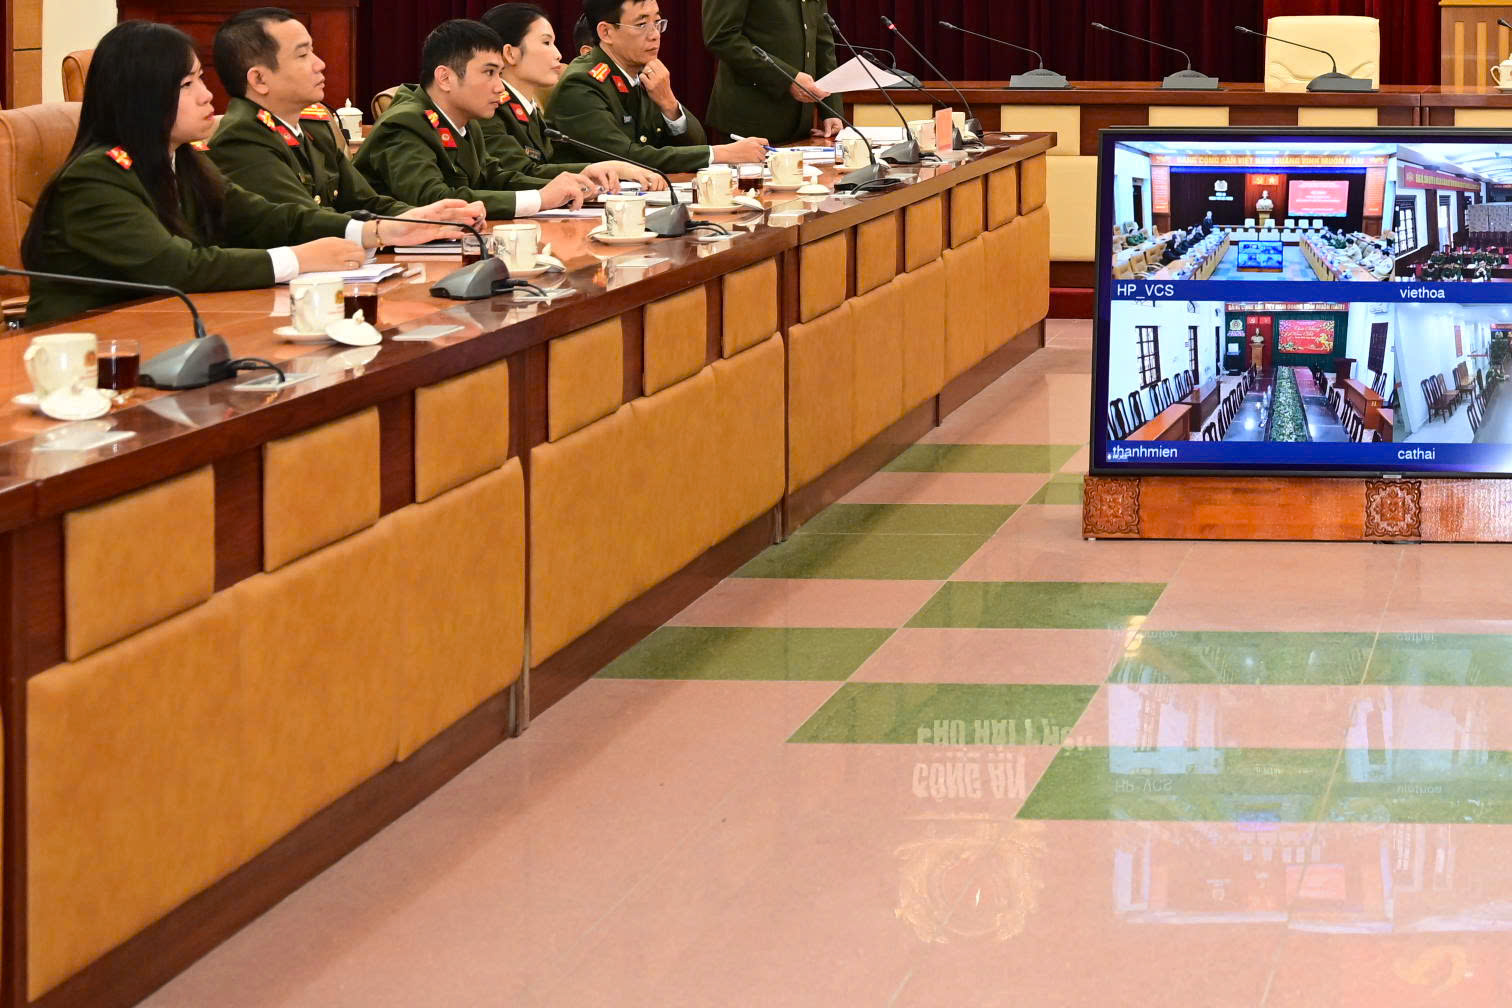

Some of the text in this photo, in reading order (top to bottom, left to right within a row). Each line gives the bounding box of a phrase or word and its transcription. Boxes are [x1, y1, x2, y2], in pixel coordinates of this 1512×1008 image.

[1399, 284, 1446, 300] viethoa
[1113, 445, 1179, 458] thanhmien
[1398, 448, 1435, 459] cathai
